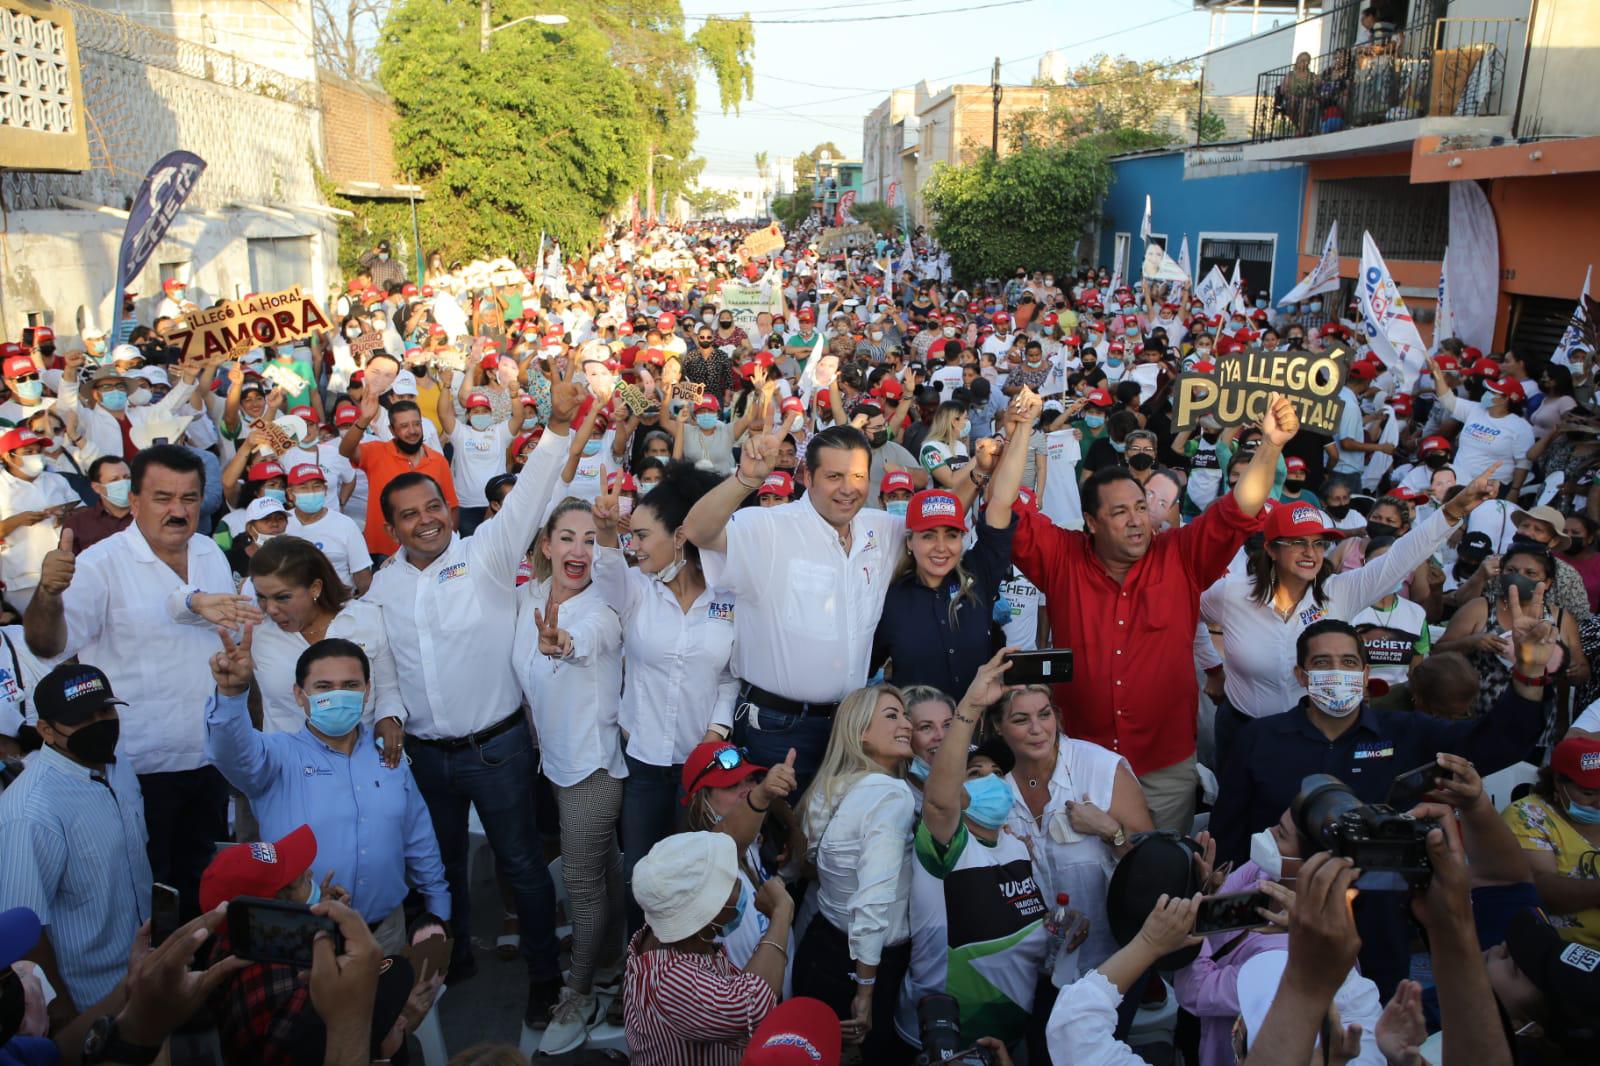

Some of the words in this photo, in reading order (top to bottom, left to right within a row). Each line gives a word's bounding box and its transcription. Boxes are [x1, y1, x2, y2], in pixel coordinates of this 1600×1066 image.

[239, 300, 259, 317] LA
[260, 288, 301, 310] HORA!
[168, 298, 329, 364] ZAMORA
[1219, 361, 1241, 387] ¡YA
[1246, 348, 1345, 397] LLEGÓ
[710, 602, 735, 612] ELSY
